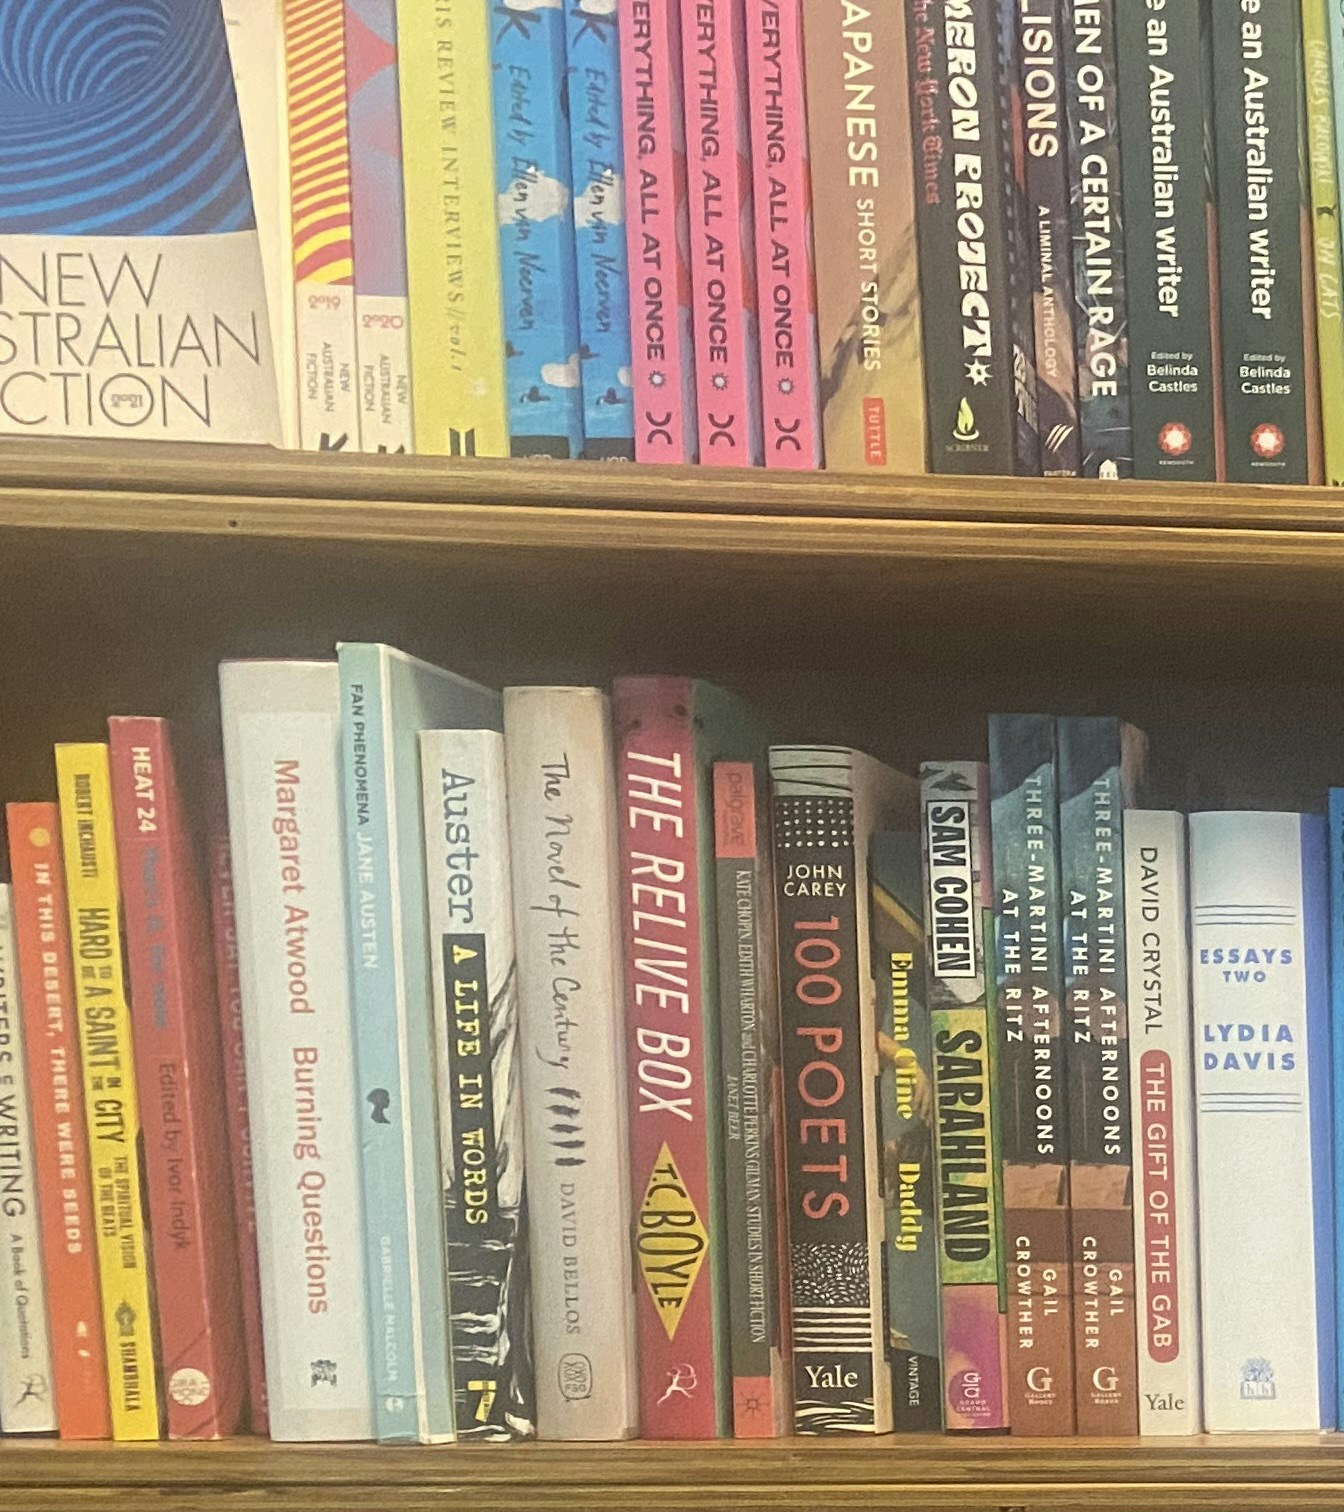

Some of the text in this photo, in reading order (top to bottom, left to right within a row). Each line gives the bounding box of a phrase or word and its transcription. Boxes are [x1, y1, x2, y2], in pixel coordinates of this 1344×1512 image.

[1148, 64, 1182, 319] Australian writer
[855, 198, 883, 372] SHORT STORIES
[306, 352, 319, 402] FICTION
[321, 342, 336, 413] AUSTRALIAN
[339, 362, 351, 395] NEW
[1146, 365, 1199, 377] Belinda
[1148, 380, 1198, 394] Castles
[442, 769, 475, 926] Auster
[785, 864, 843, 880] JOHN
[783, 880, 848, 898] CAREY
[930, 805, 972, 973] SAM COHEN
[628, 750, 693, 1122] THE RELIVE BOX
[1139, 846, 1163, 1035] DAVID CRYSTAL
[1199, 948, 1293, 967] ESSAYS
[1222, 969, 1267, 984] TWO
[272, 758, 329, 1315] Margaret Atwood Burning Questions
[1203, 1024, 1294, 1044] LYDIA
[793, 917, 849, 1220] 100 POETS
[1202, 1051, 1297, 1072] DAVIS
[935, 1029, 992, 1264] SARAHLAND
[804, 1365, 859, 1391] Yale
